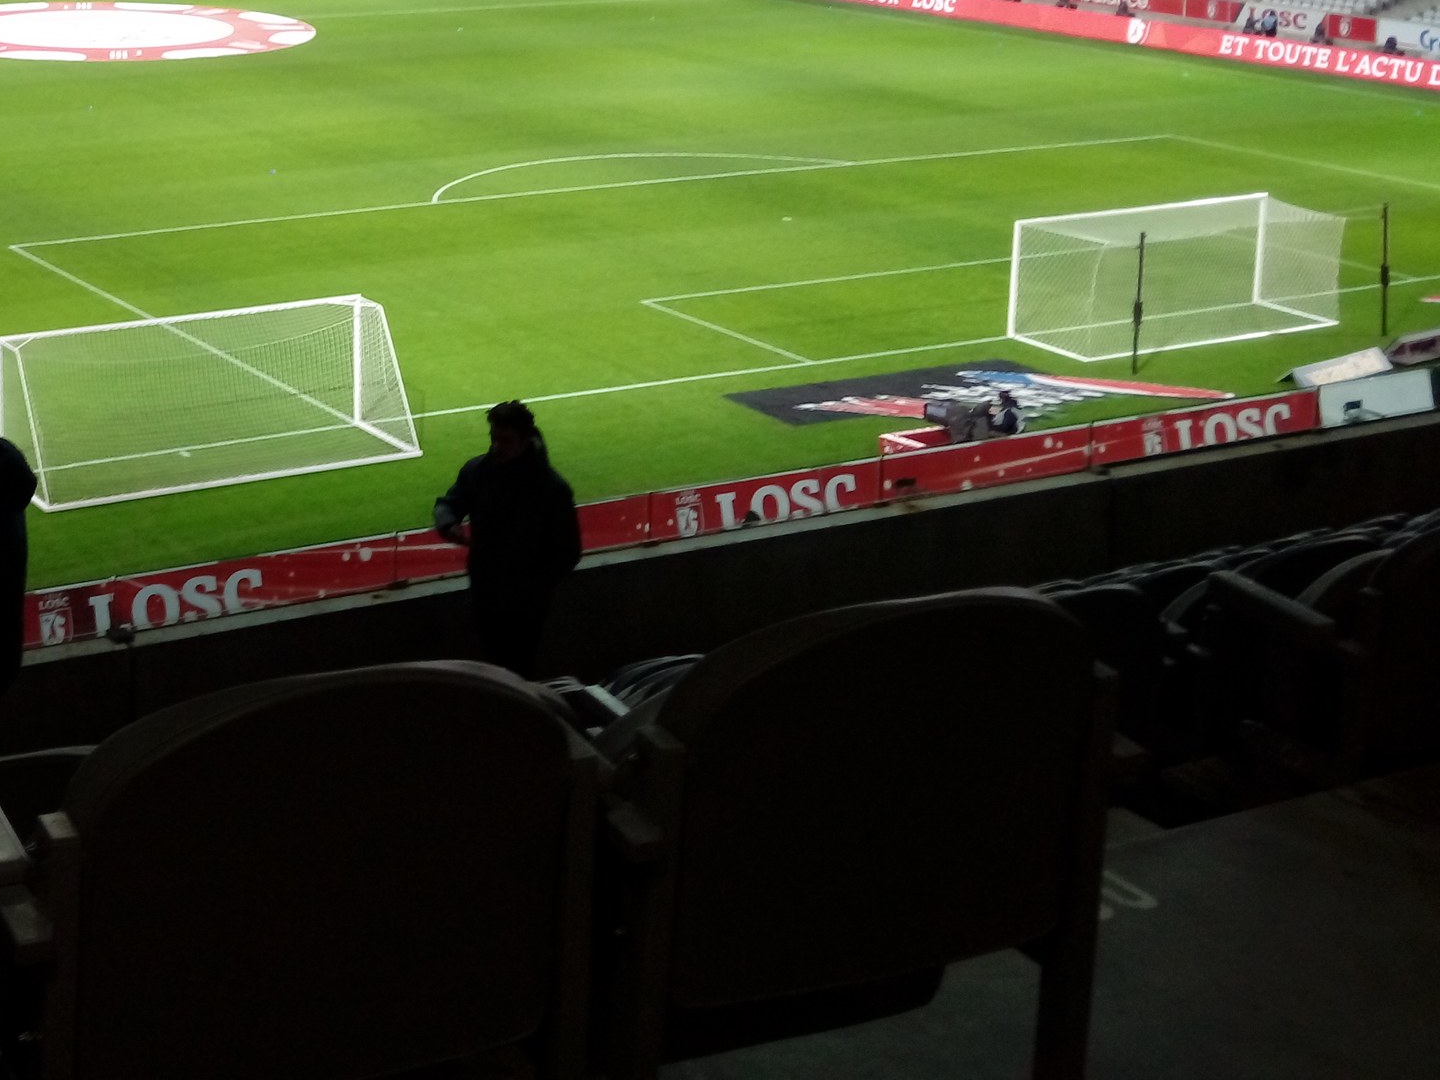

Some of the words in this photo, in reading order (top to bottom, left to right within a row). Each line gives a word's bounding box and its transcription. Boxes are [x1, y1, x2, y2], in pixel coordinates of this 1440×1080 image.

[1218, 34, 1250, 56] ET
[1254, 40, 1330, 70] TOUTE
[1335, 51, 1424, 83] L'ACTU
[1174, 403, 1291, 452] LOSC
[714, 473, 856, 531] LOSC
[87, 568, 263, 637] LOSC
